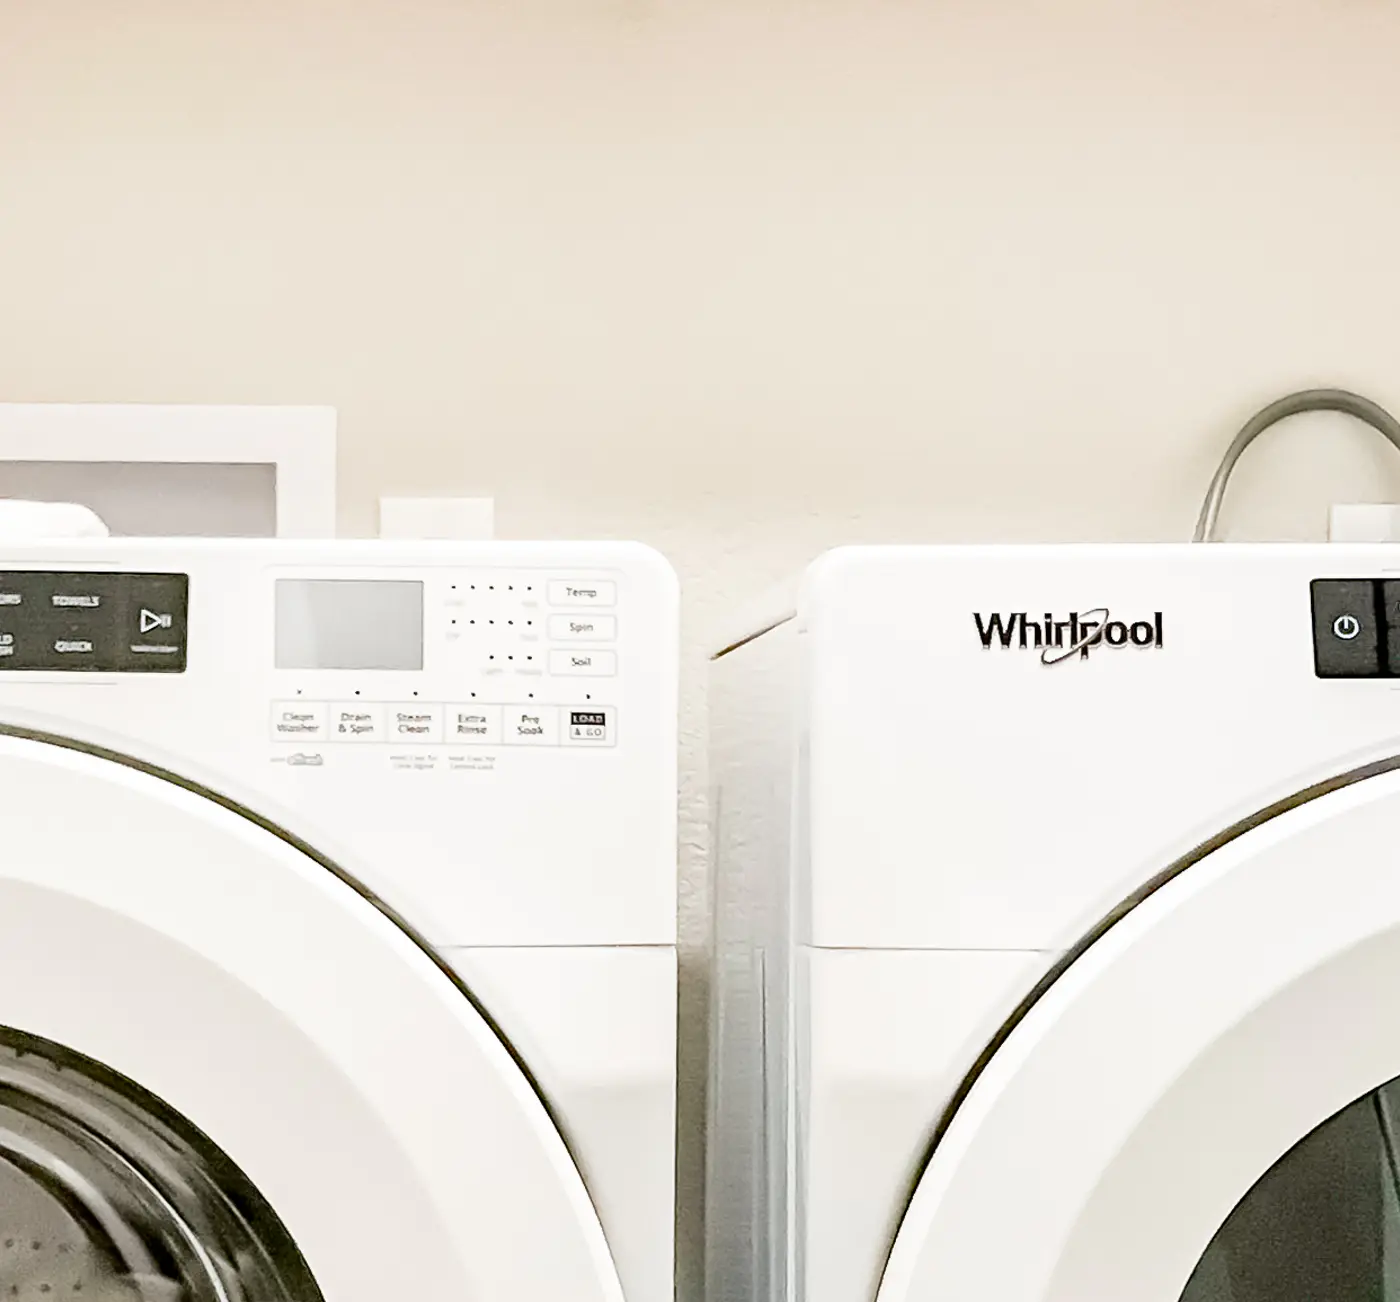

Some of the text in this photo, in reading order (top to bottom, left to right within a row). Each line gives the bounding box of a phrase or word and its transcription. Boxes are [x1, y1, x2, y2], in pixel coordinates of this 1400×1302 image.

[566, 587, 597, 598] Temp
[569, 622, 594, 633] Spin
[973, 608, 1163, 664] Whirlpool
[571, 657, 592, 666] Soil
[282, 712, 314, 721] Clean
[341, 712, 371, 721] Drain
[396, 713, 432, 722] Steam
[457, 714, 487, 724] Extra
[521, 714, 540, 724] Pre
[572, 714, 604, 724] LOAD
[277, 723, 319, 733] Washer
[338, 724, 374, 734] & Spin
[398, 724, 430, 733] Clean
[457, 725, 488, 735] Rinse
[517, 726, 544, 736] Soak
[586, 727, 602, 737] GO
